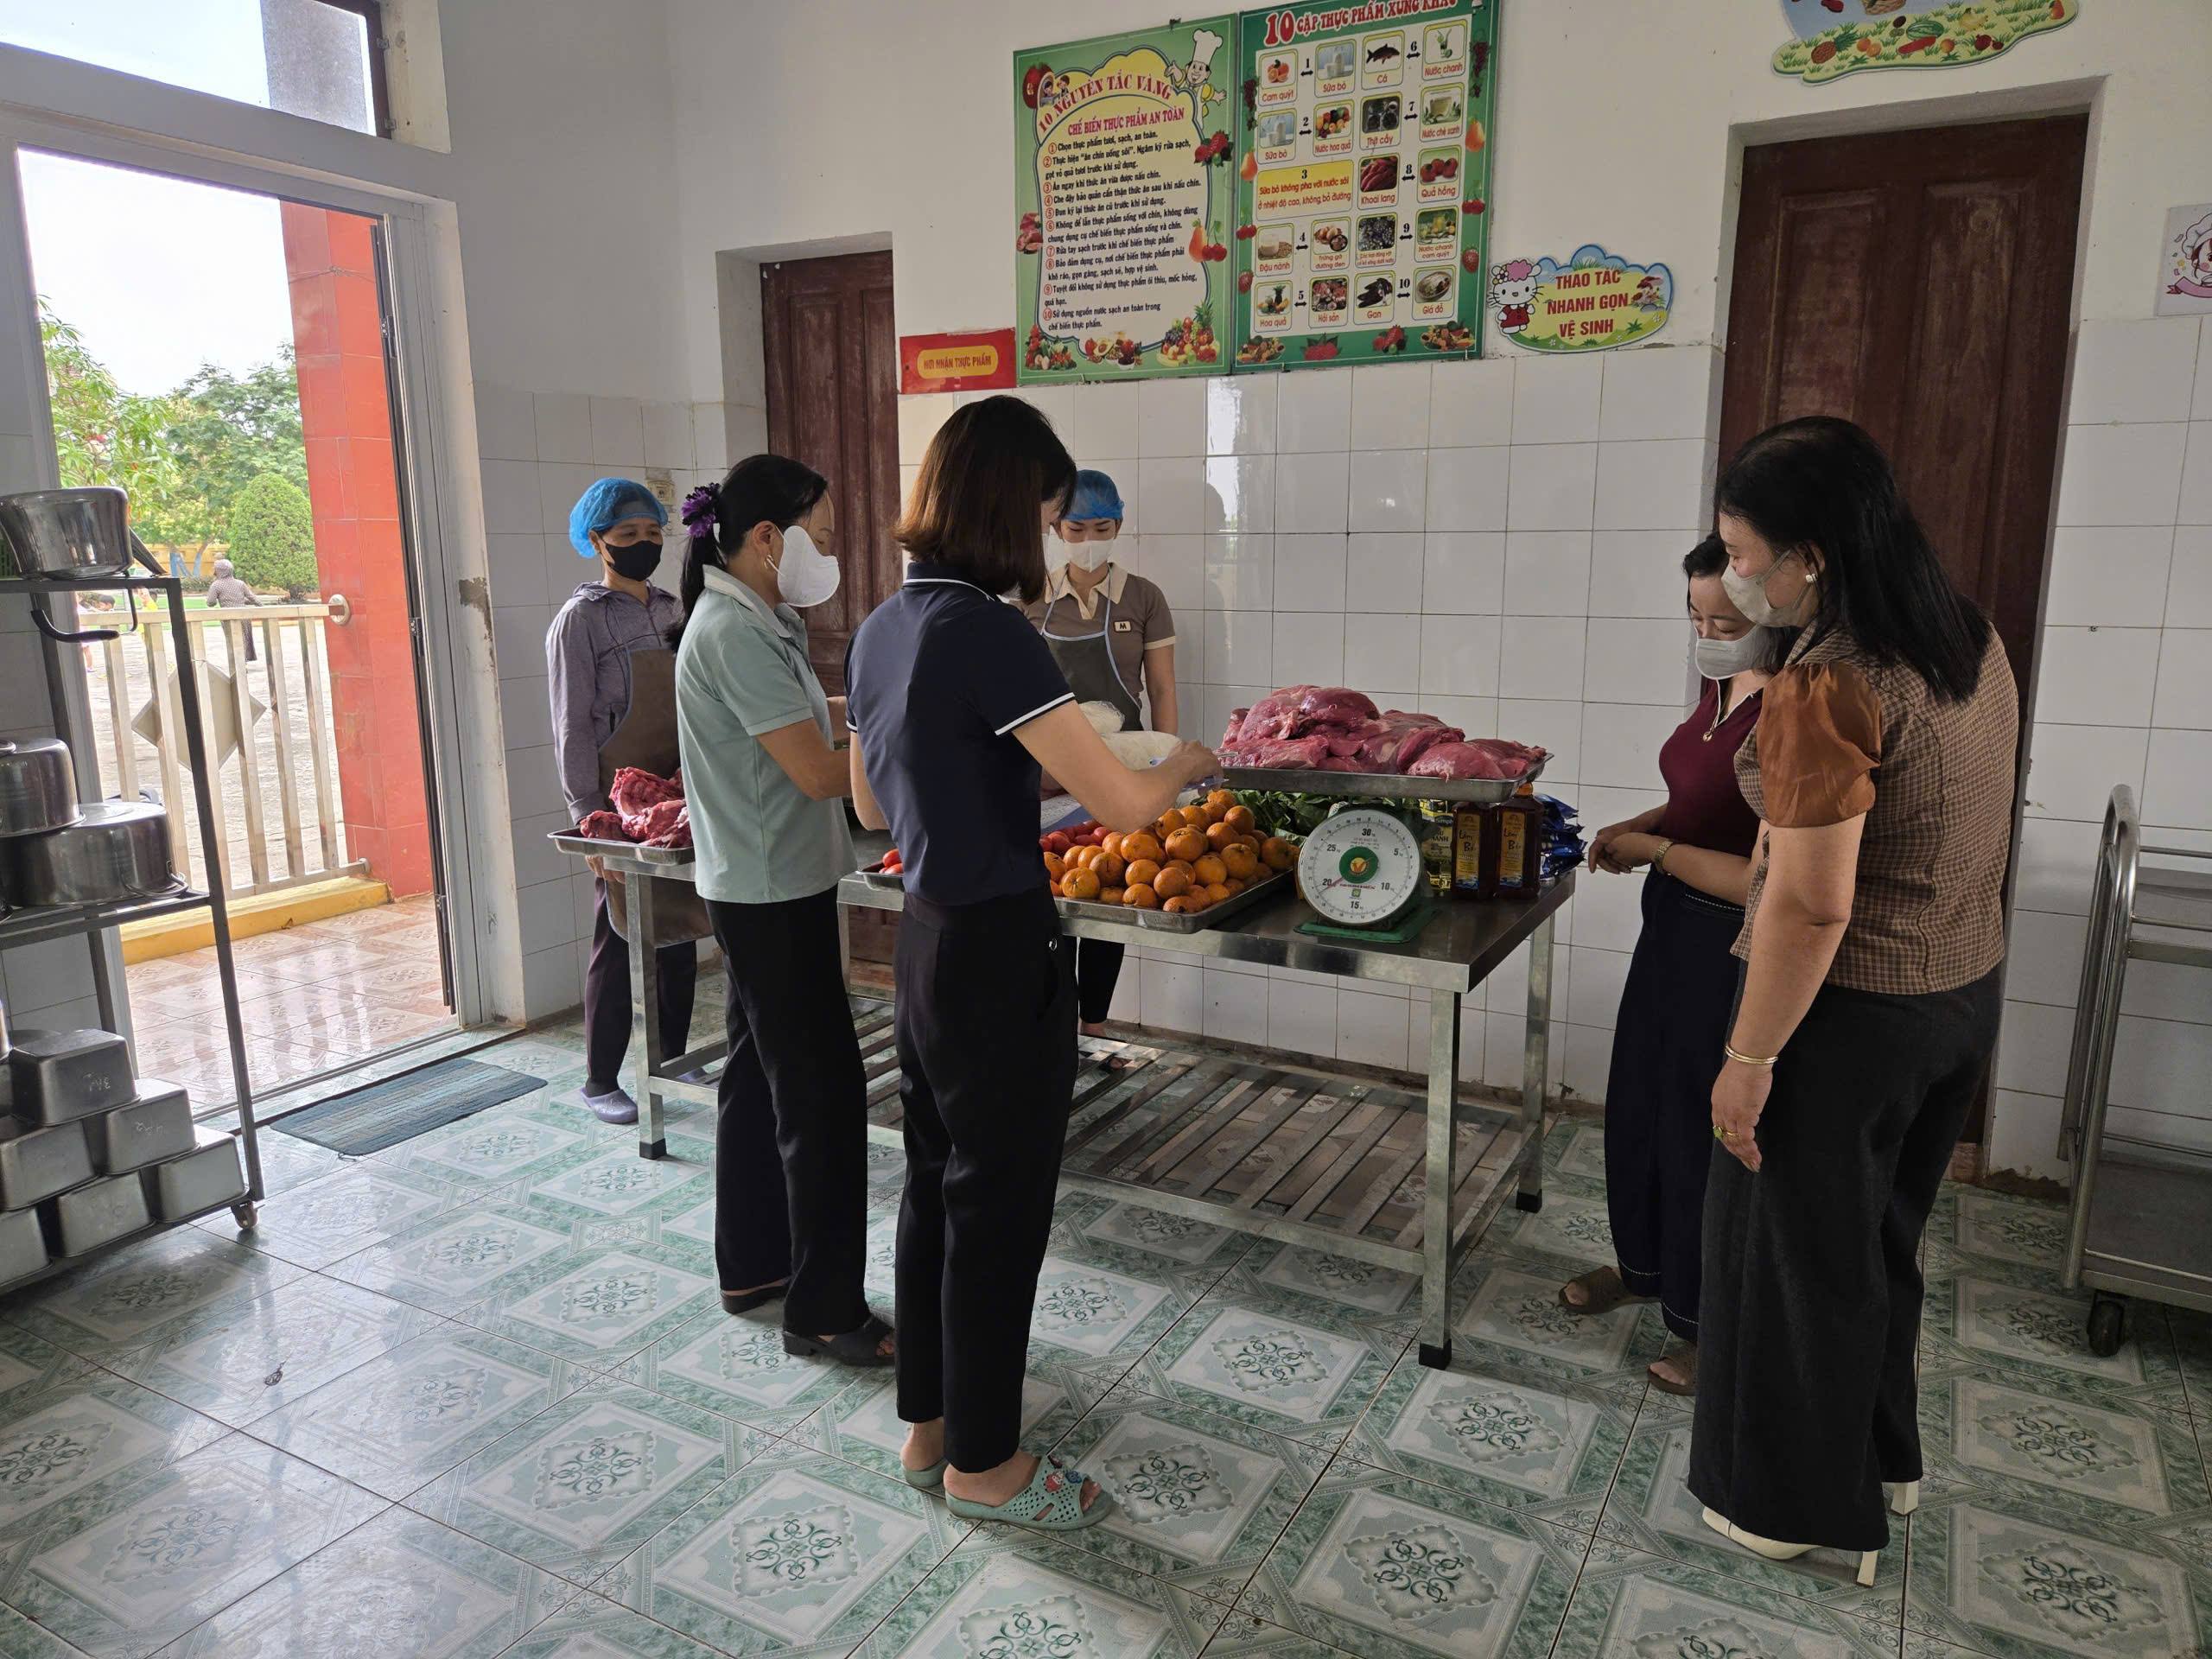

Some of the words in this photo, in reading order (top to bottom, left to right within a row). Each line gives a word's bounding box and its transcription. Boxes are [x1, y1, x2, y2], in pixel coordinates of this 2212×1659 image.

[1264, 11, 1295, 46] 10
[1296, 14, 1319, 35] CẶP
[1319, 9, 1349, 29] THỰC
[1387, 0, 1419, 16] XUNG
[1410, 41, 1417, 51] 6
[1306, 58, 1310, 68] 1
[1424, 66, 1441, 76] Nước
[1442, 62, 1463, 73] chanh
[1376, 74, 1388, 83] Cá
[1323, 83, 1336, 92] Sữa
[1337, 81, 1346, 90] bò
[1039, 112, 1053, 133] 10
[1053, 79, 1103, 118] NGUYÊN
[1107, 69, 1132, 91] TẮC
[1137, 73, 1173, 100] VÀNG
[1262, 92, 1278, 102] Cam
[1279, 90, 1294, 100] quýt
[1408, 101, 1414, 111] 7
[1068, 118, 1082, 136] CHẾ
[1084, 116, 1101, 134] BIẾN
[1103, 114, 1123, 132] THỰC
[1126, 107, 1147, 128] PHẨM
[1149, 111, 1160, 124] AN
[1163, 105, 1185, 123] TOÀN
[1303, 117, 1309, 127] 2
[1421, 129, 1435, 138] Nước
[1447, 126, 1460, 135] xanh
[1314, 144, 1328, 154] Nước
[1331, 143, 1339, 151] hoa
[1340, 140, 1351, 150] quả
[1265, 150, 1277, 160] Sữa
[1279, 149, 1287, 158] bò
[1301, 169, 1307, 180] 3
[1406, 164, 1412, 174] 8
[1259, 186, 1270, 195] Sữa
[1271, 185, 1279, 194] bò
[1281, 183, 1300, 193] không
[1300, 181, 1312, 191] pha
[1313, 179, 1323, 188] với
[1323, 178, 1338, 187] nước
[1339, 176, 1349, 185] sôi
[1421, 187, 1436, 198] Quả
[1438, 185, 1456, 196] hồng
[1263, 199, 1277, 210] nhiệt
[1279, 198, 1287, 207] độ
[1302, 195, 1321, 205] không
[1322, 193, 1331, 201] bỏ
[1332, 192, 1351, 201] đường
[1361, 194, 1379, 205] Khoai
[1380, 194, 1395, 204] lang
[1403, 223, 1410, 232] 9
[1300, 232, 1306, 242] 4
[1259, 264, 1272, 273] Đậu
[1274, 262, 1290, 270] nành
[1400, 278, 1410, 289] 10
[1556, 273, 1591, 290] THAO
[1594, 267, 1621, 285] TÁC
[1298, 290, 1304, 300] 5
[1422, 305, 1433, 314] Giá
[1435, 303, 1443, 314] đỗ
[1547, 296, 1594, 315] NHANH
[1599, 292, 1629, 312] GỌN
[1367, 310, 1382, 319] Gan
[1260, 319, 1272, 327] Hoa
[1274, 317, 1287, 327] quả
[1559, 319, 1576, 340] VỆ
[1580, 319, 1613, 334] SINH
[936, 355, 954, 371] NHẬN
[954, 355, 971, 370] THỰC
[972, 352, 992, 366] PHẨM
[1394, 848, 1399, 856] 5
[1322, 878, 1332, 887] 20
[1381, 882, 1390, 891] 10
[1351, 900, 1360, 910] 15
